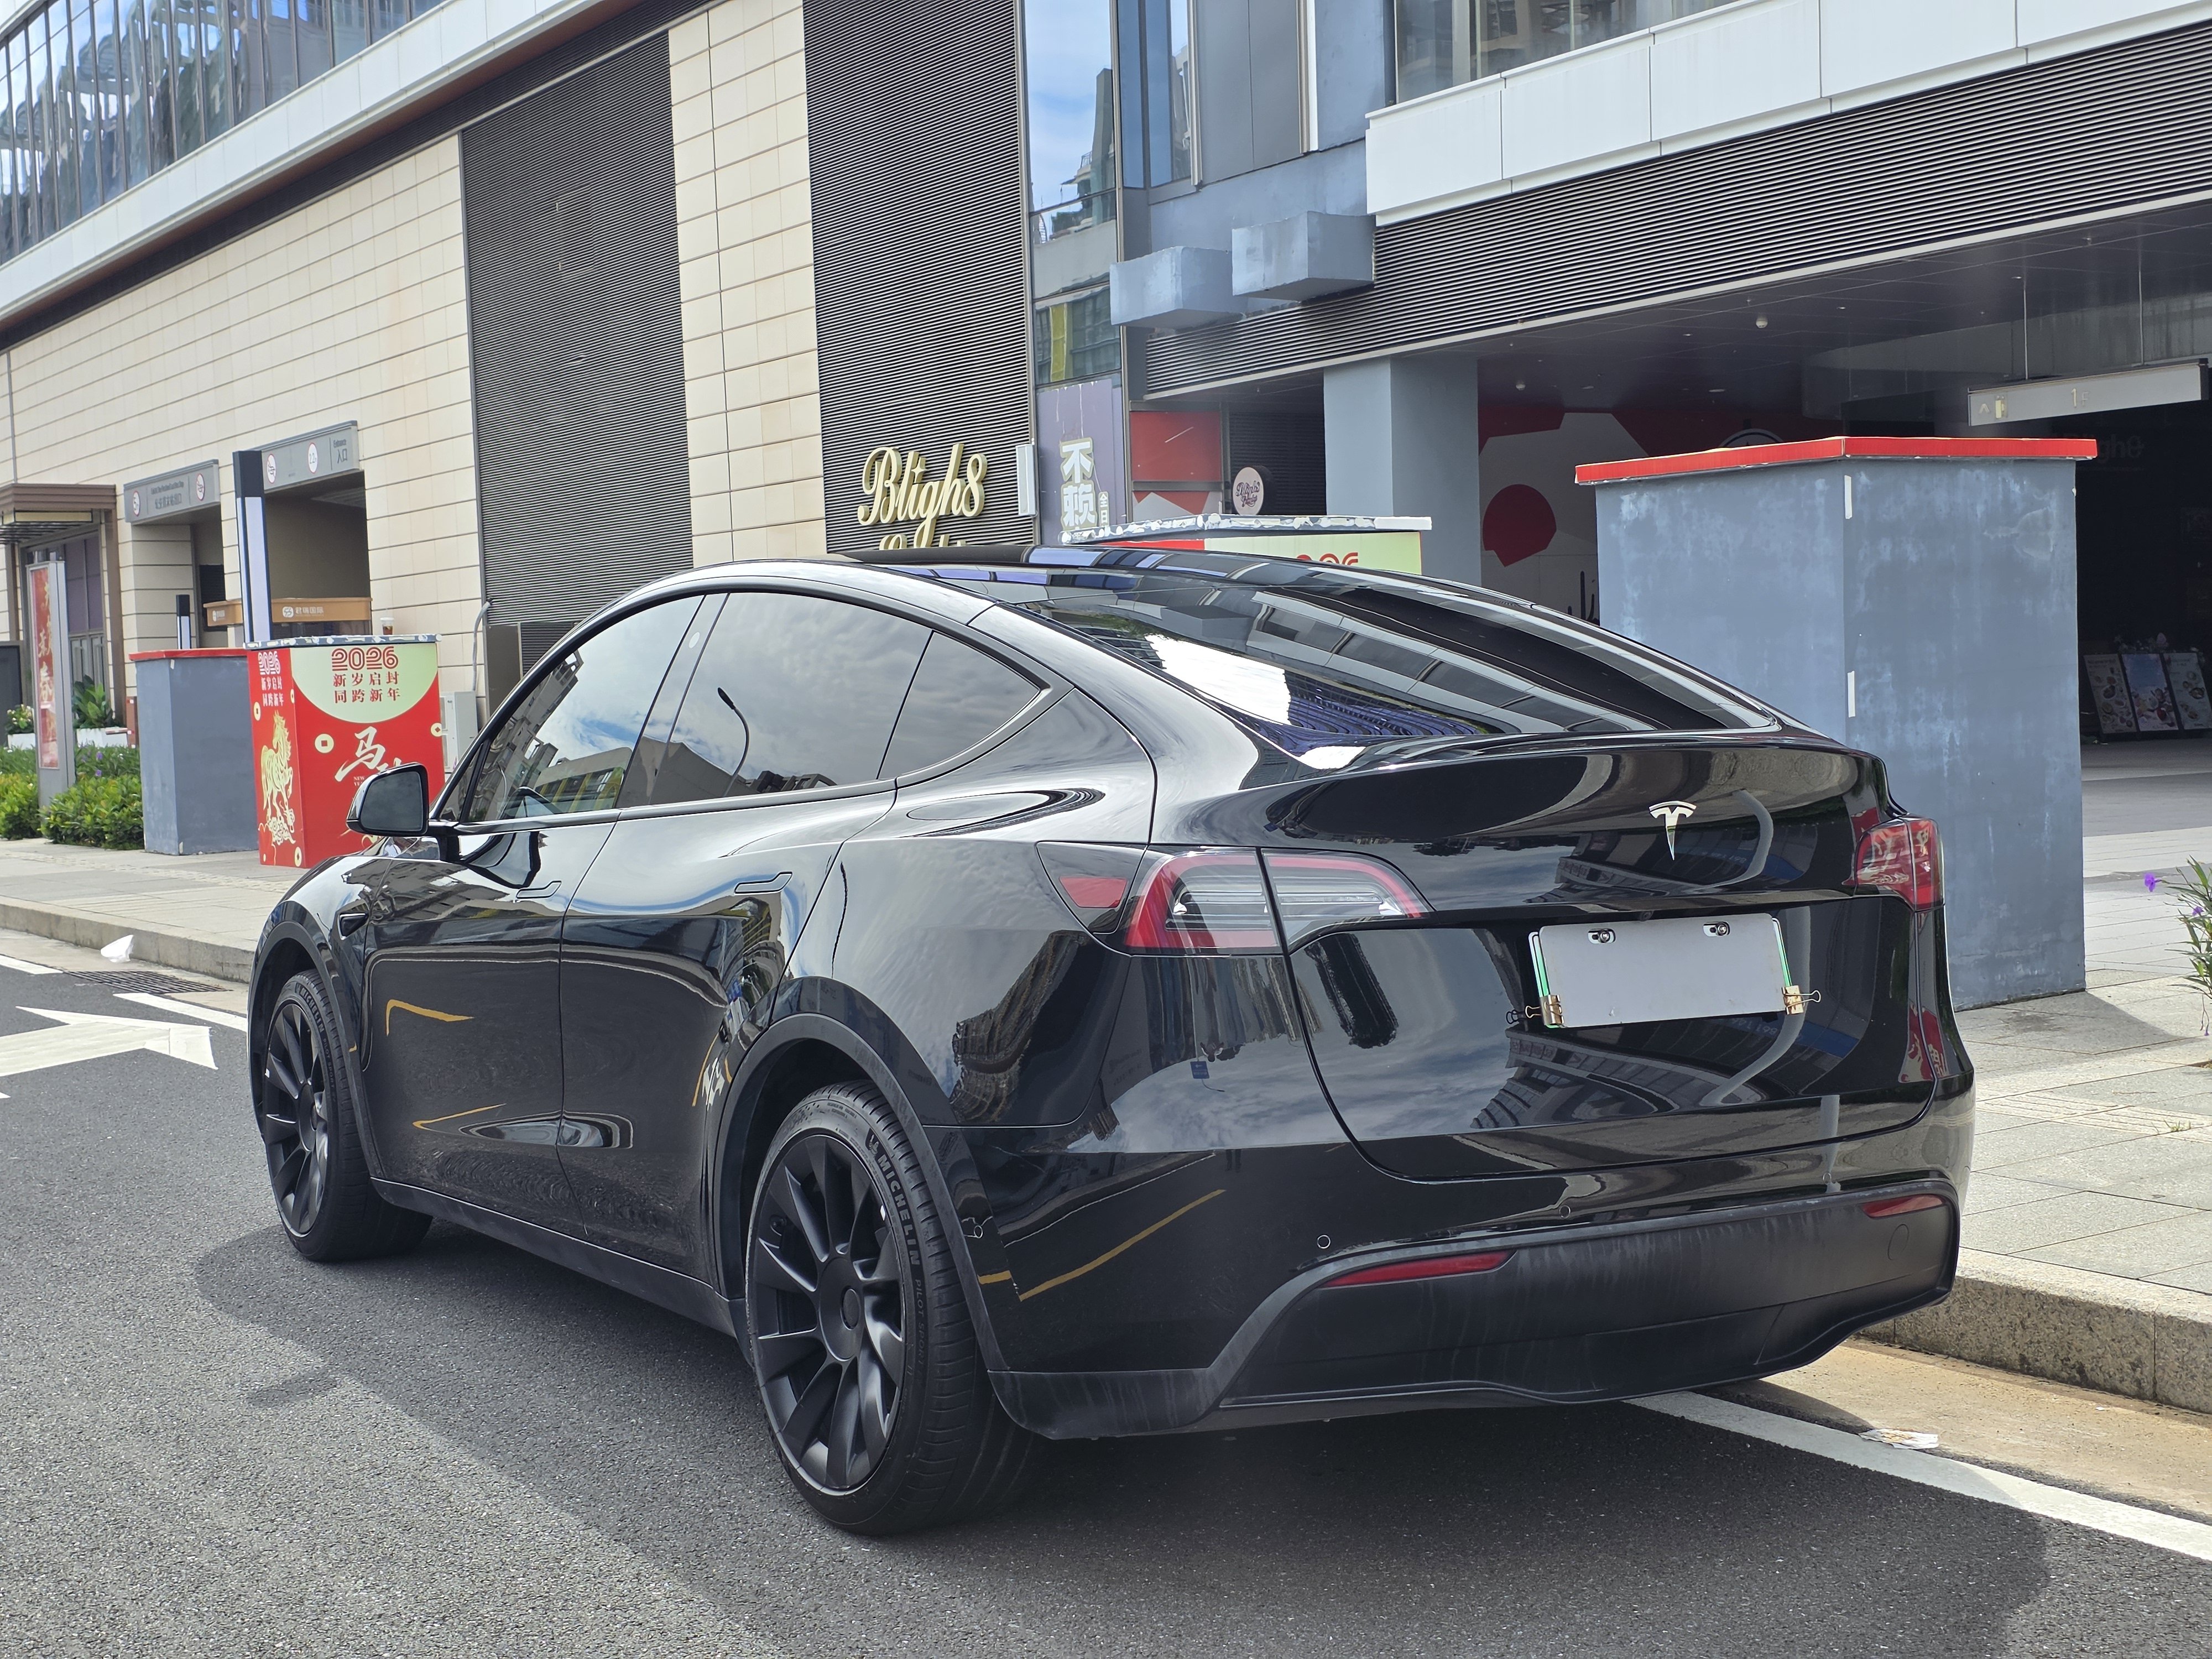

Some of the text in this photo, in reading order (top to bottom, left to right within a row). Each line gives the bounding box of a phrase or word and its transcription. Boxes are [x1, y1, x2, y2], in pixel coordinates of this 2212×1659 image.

[337, 448, 348, 464] 入口
[1060, 440, 1096, 530] 不赖
[258, 650, 281, 675] 2026
[331, 646, 399, 671] 2026
[333, 671, 399, 687] 新岁启封
[334, 687, 401, 704] 同跨新年
[334, 726, 402, 782] 马
[877, 1154, 921, 1265] MICHELIN
[915, 1279, 925, 1318] PILOT
